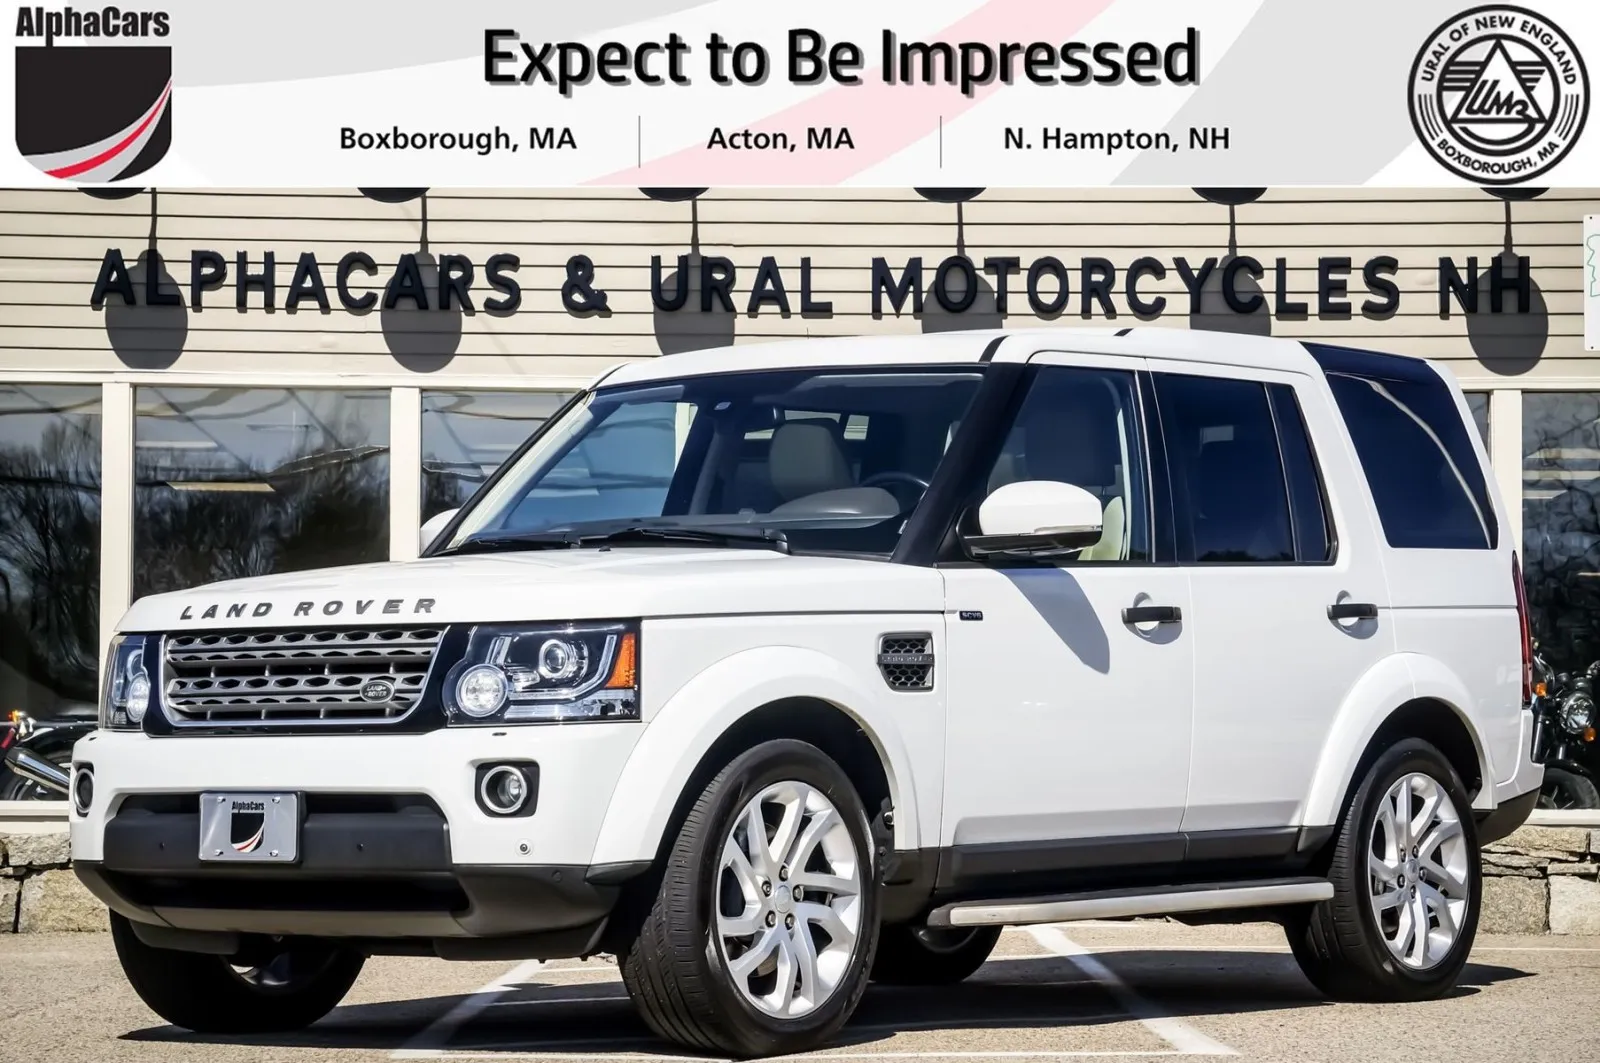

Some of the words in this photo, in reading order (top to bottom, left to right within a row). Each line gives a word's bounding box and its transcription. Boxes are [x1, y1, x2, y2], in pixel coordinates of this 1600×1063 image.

[91, 247, 522, 314] ALPHACARS
[561, 253, 612, 318] &
[650, 254, 834, 319] URAL
[872, 254, 1401, 321] MOTORCYCLES
[1438, 256, 1532, 320] NH
[179, 602, 274, 620] LAND
[293, 598, 436, 617] ROVER
[231, 801, 265, 813] AlphaCars
